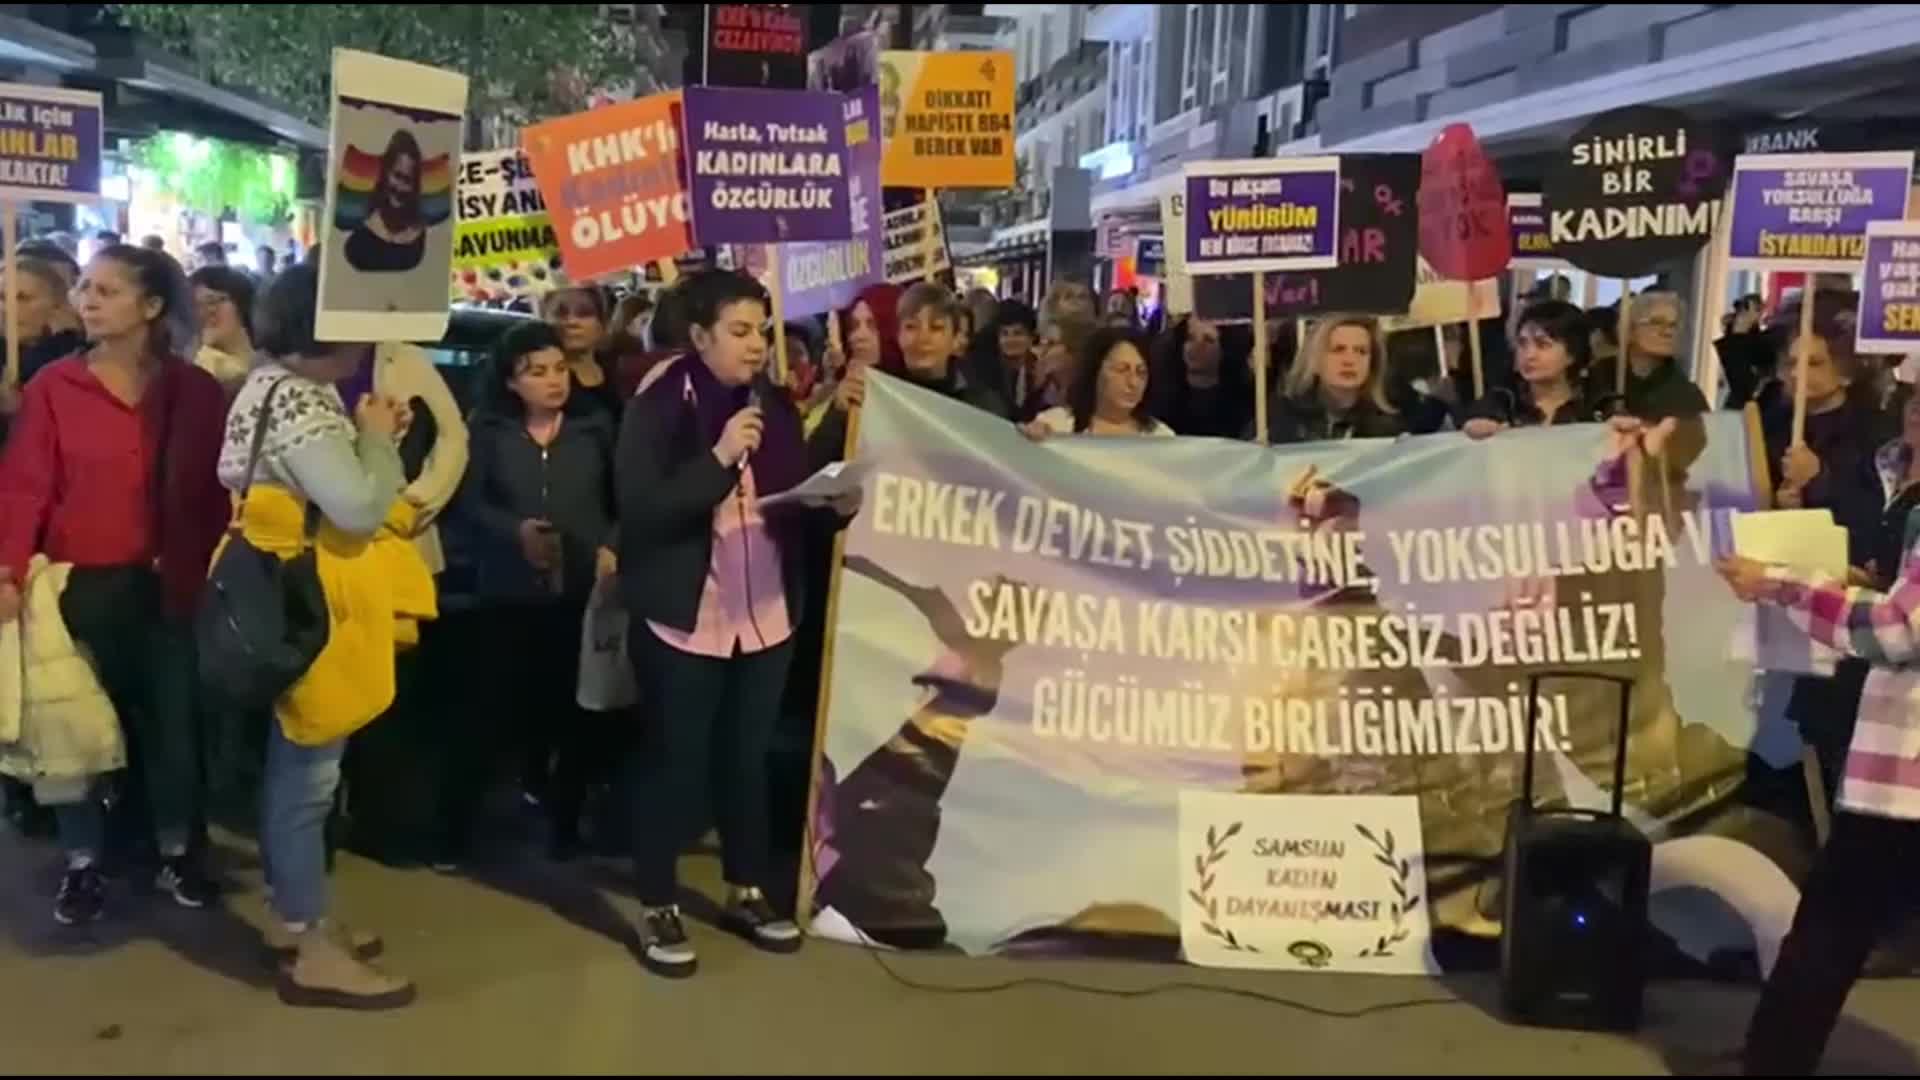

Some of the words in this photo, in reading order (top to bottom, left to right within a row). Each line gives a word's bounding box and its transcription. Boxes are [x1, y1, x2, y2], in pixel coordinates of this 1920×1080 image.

[703, 120, 763, 144] Hasta,
[766, 122, 828, 144] Tutsak
[1571, 128, 1687, 166] SİNİRLİ
[696, 150, 841, 177] KADINLARA
[710, 180, 833, 210] ÖZGÜRLÜK
[1602, 165, 1654, 196] BİR
[1207, 201, 1318, 234] YÜRÜRÜM
[1550, 200, 1722, 244] KADINIM!
[872, 473, 1005, 549] ERKEK
[1011, 495, 1153, 571] DEVLET
[1165, 516, 1380, 594] ŞİDDETİNE,
[1388, 504, 1679, 586] YOKSULLUĞA
[965, 579, 1126, 661] SAVAŞA
[1136, 601, 1258, 676] KARŞI
[1271, 602, 1449, 681] ÇARESİZ
[1458, 591, 1642, 668] DEĞİLİZ!
[1031, 668, 1233, 751] GÜCÜMÜZ
[1245, 682, 1573, 756] BİRLİĞİMİZDİR!
[1252, 837, 1346, 859] SAMSUN
[1266, 868, 1338, 890] KADIN
